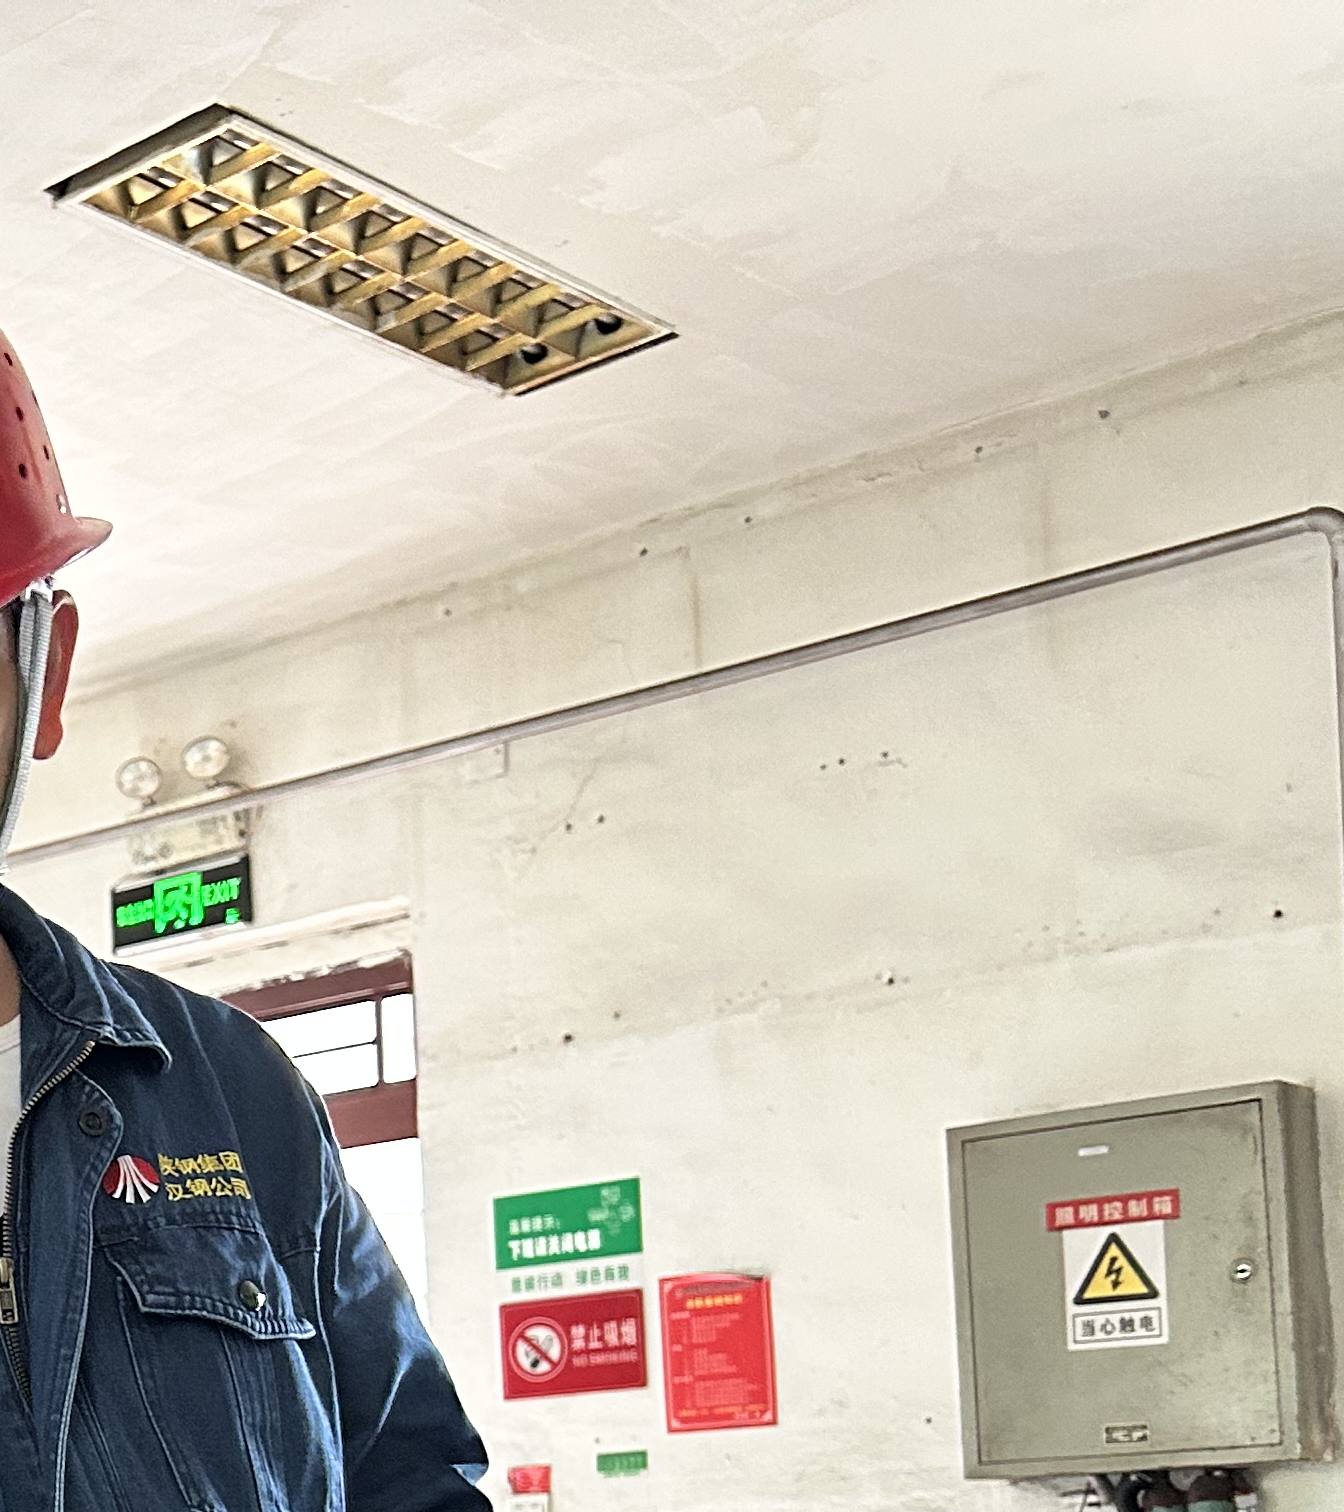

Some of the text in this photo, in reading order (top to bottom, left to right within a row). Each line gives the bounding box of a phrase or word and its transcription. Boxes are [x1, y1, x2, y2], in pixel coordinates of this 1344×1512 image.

[201, 876, 242, 907] EXIT
[1054, 1195, 1173, 1228] 照明控制箱
[570, 1317, 637, 1352] 禁止吸烟
[1081, 1314, 1156, 1338] 当心触电
